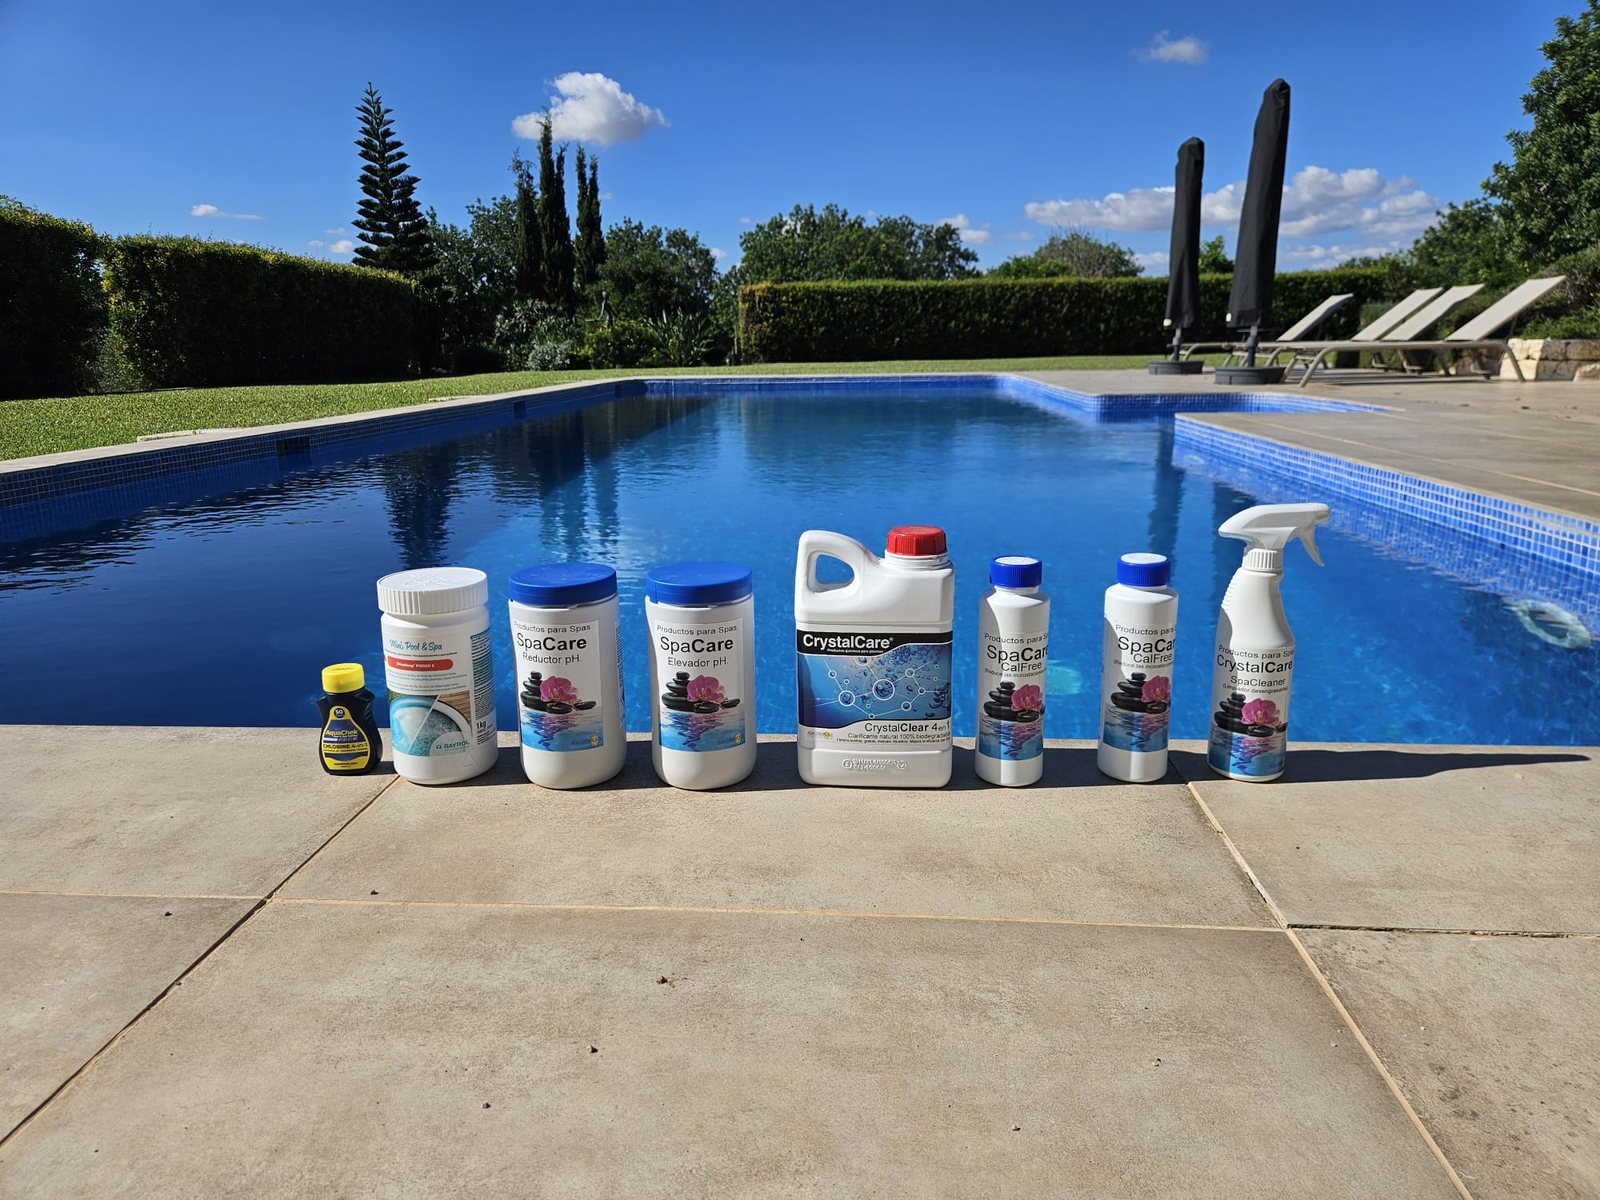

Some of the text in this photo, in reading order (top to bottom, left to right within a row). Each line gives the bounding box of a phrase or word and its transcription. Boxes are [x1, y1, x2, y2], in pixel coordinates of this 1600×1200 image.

[514, 621, 545, 633] Productos
[570, 624, 591, 633] Spas
[657, 625, 694, 636] Productos
[718, 625, 737, 634] Spas
[1115, 624, 1158, 635] Productos
[517, 633, 587, 652] SpaCare
[985, 633, 1024, 644] Productos
[1027, 636, 1042, 645] para
[405, 641, 420, 651] Pool
[422, 641, 428, 651] &
[428, 641, 443, 652] Spa
[660, 637, 734, 655] SpaCare
[1118, 636, 1176, 655] SpaCar
[523, 652, 562, 664] Reductor
[1218, 644, 1259, 658] Productos
[1262, 652, 1281, 660] para
[668, 657, 710, 667] Elevador
[1133, 653, 1173, 664] CalFree
[1217, 654, 1293, 673] CrystalCare
[1001, 662, 1042, 672] CalFree
[1231, 676, 1286, 687] SpaCleaner
[865, 722, 929, 735] CrystalClear
[444, 740, 470, 749] BAYROL
